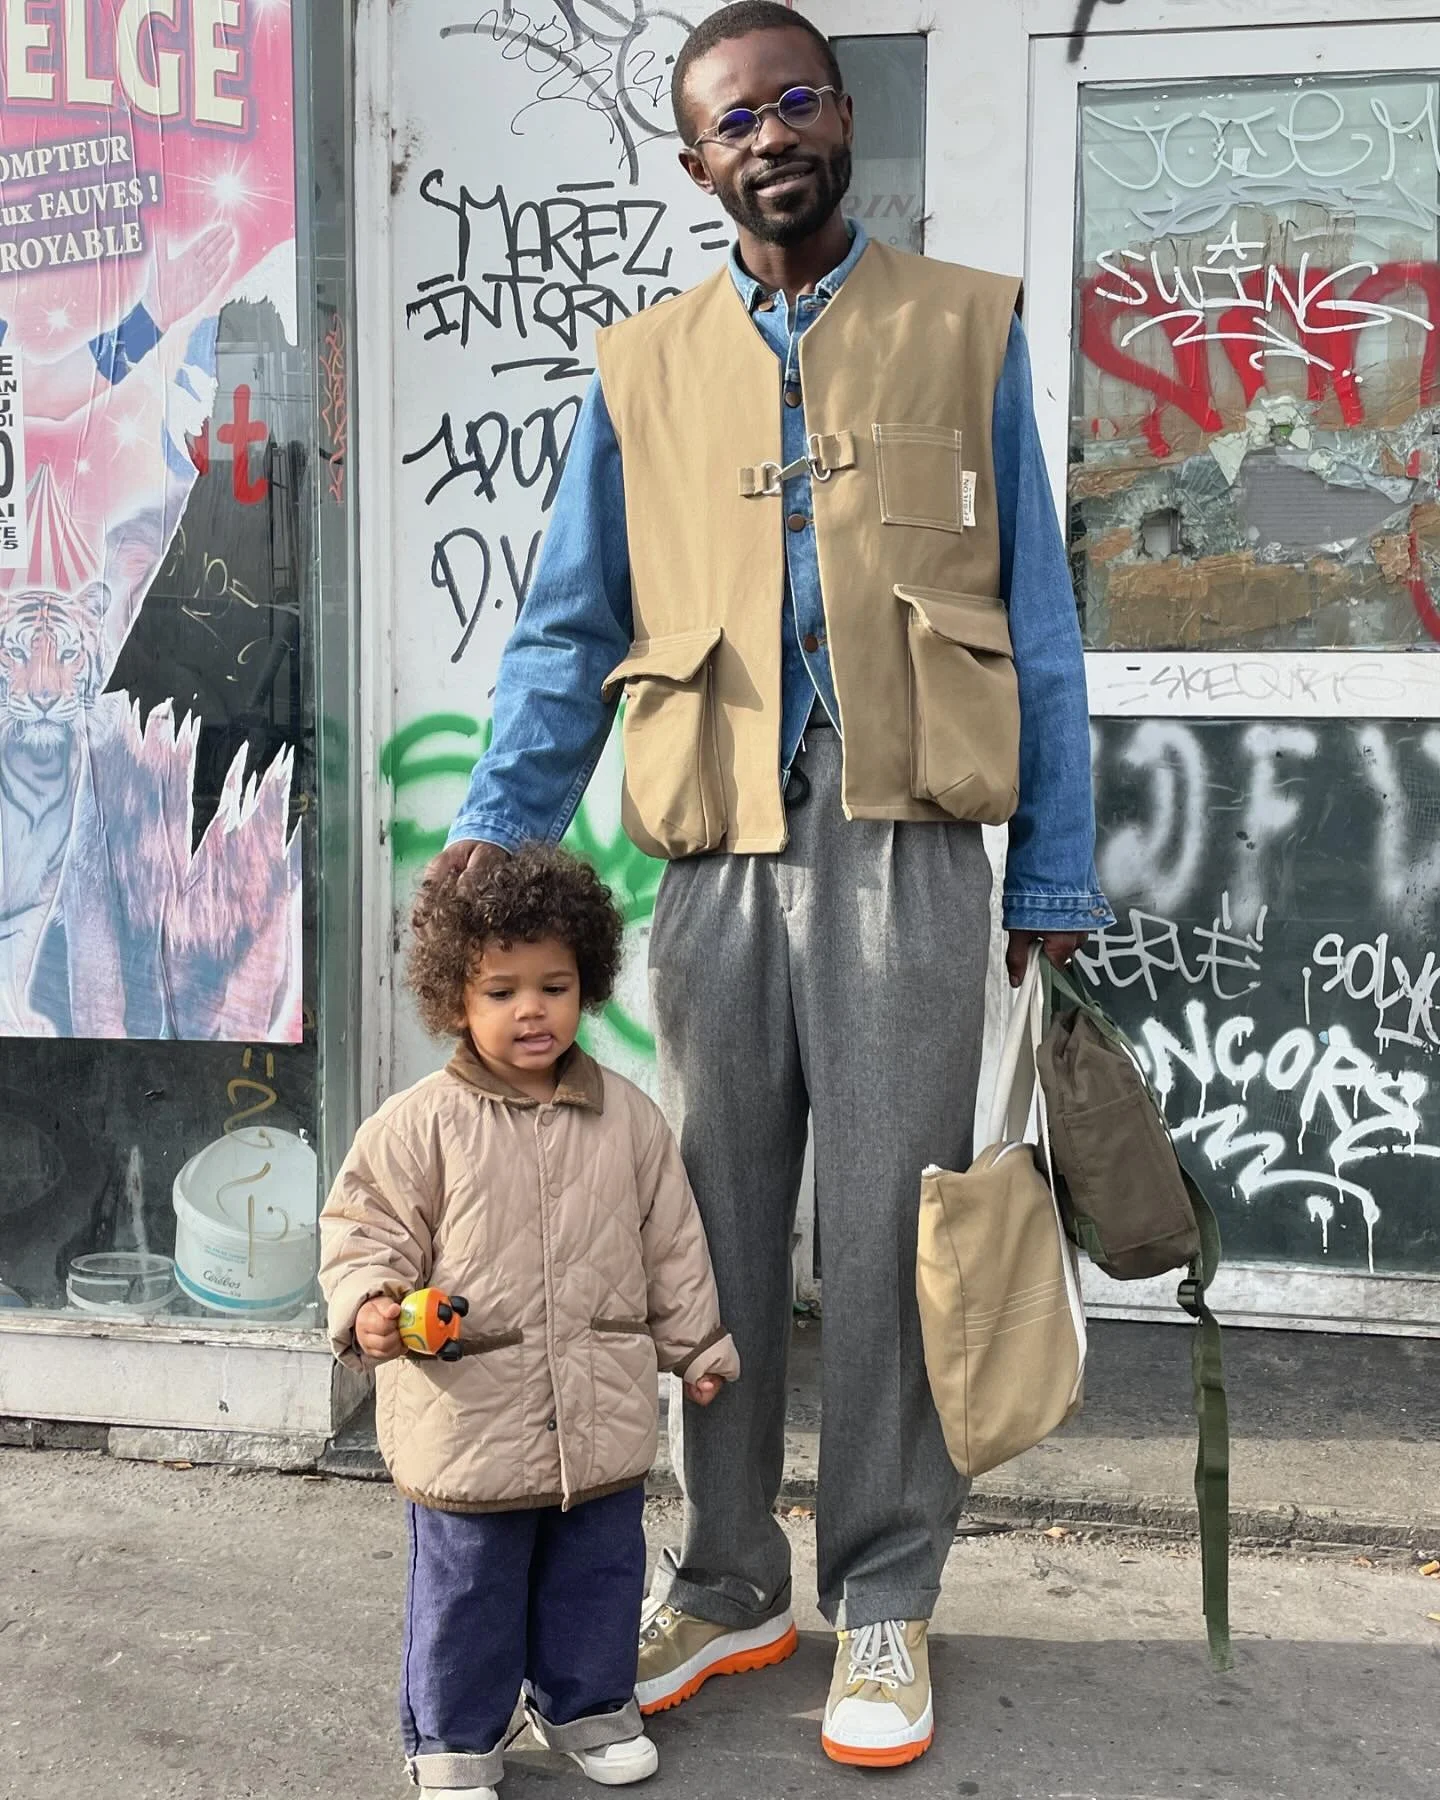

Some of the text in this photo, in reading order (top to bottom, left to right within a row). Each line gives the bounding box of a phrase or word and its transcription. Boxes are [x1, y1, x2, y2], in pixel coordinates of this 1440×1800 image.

[0, 203, 35, 227] ux
[38, 177, 143, 221] FAUVES
[0, 222, 143, 273] ROYABLE
